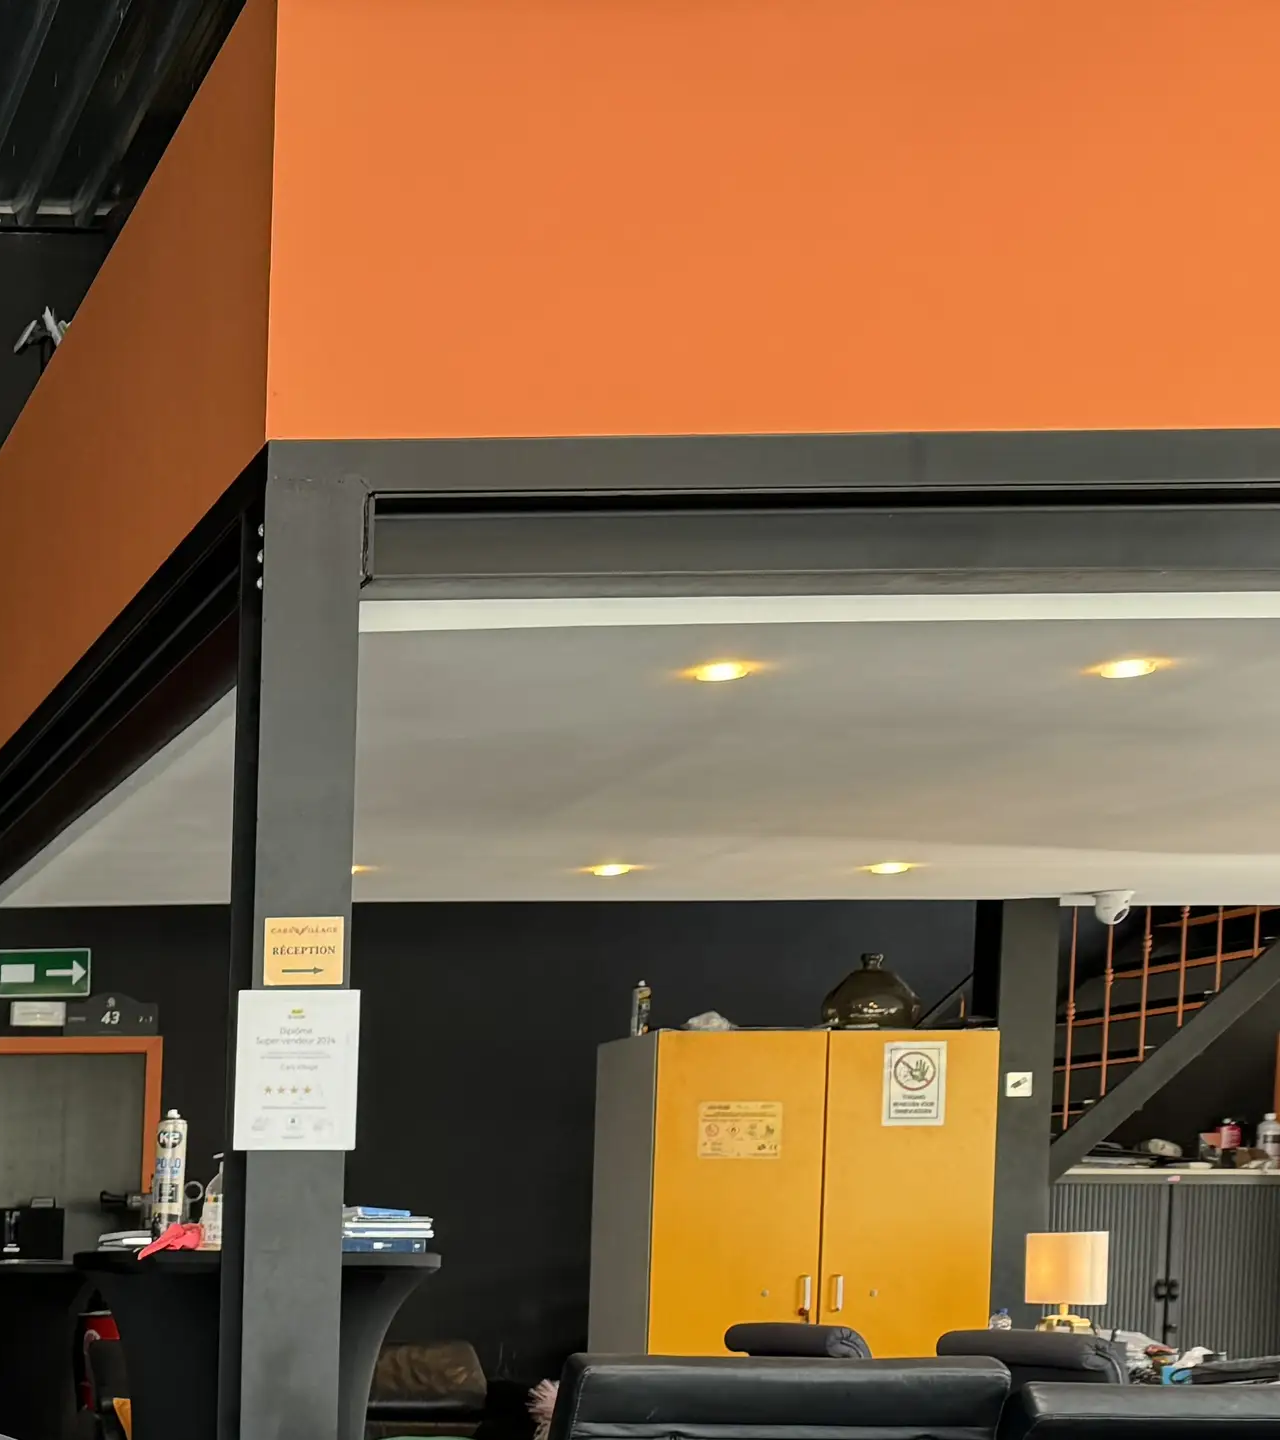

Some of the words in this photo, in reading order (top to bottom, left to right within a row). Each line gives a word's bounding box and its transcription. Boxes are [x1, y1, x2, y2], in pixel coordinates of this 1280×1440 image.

[272, 945, 336, 956] RÉCEPTION
[100, 1011, 120, 1024] 43
[159, 1132, 180, 1144] K2
